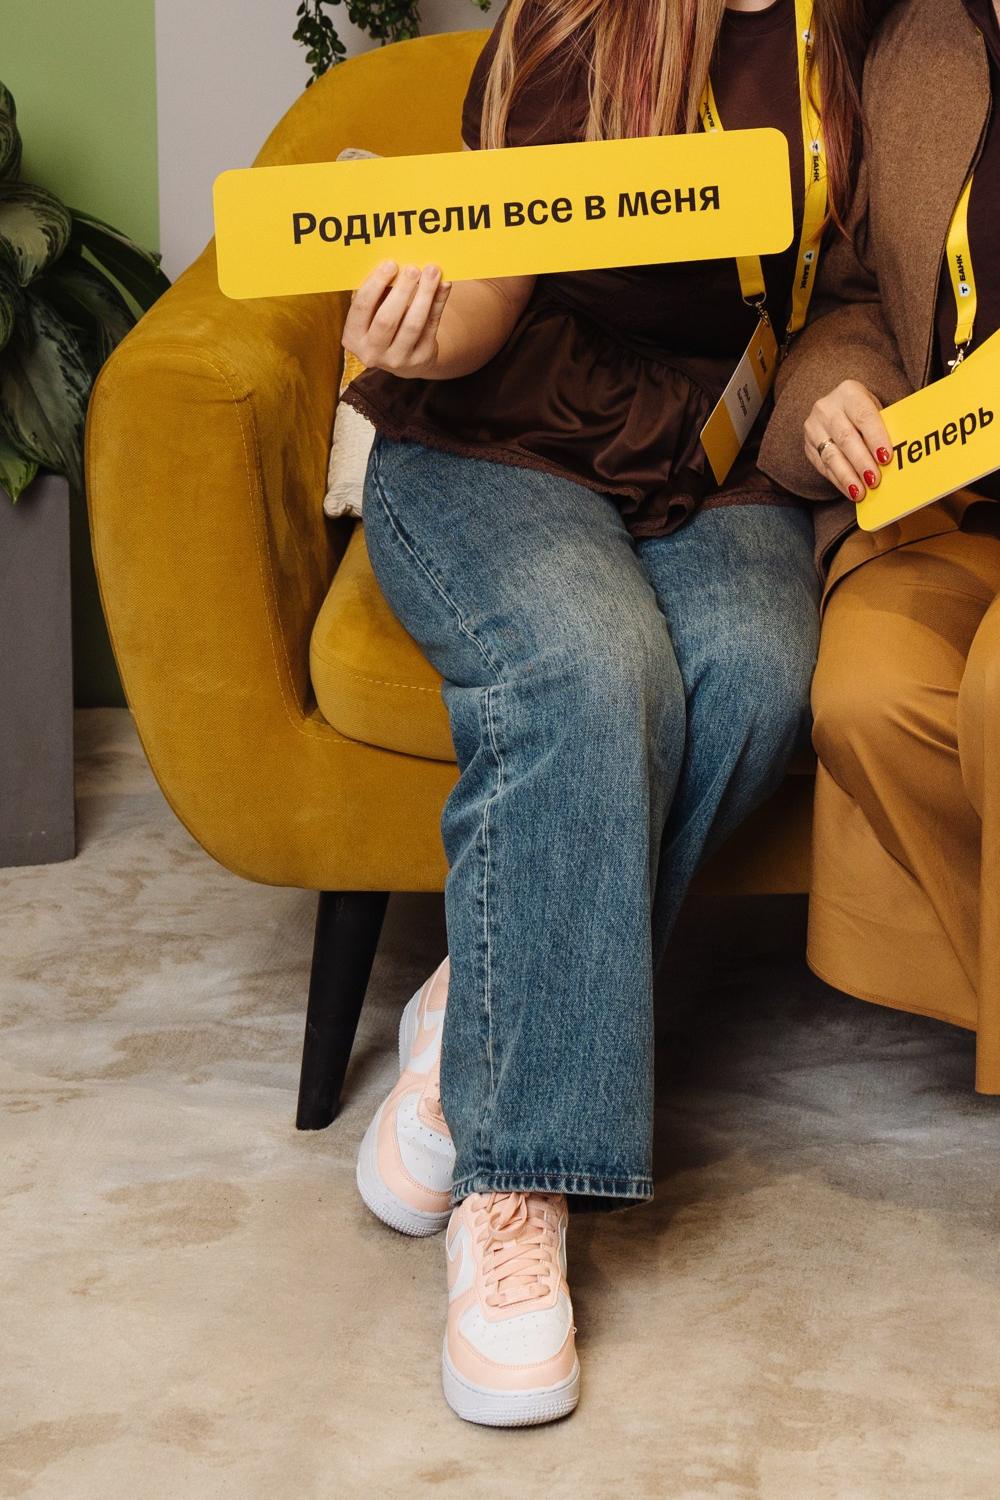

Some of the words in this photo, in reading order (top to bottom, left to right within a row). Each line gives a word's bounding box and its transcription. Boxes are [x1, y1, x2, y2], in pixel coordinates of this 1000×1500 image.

[812, 155, 820, 182] БАНК
[292, 204, 491, 247] Родители
[503, 197, 574, 227] все
[584, 195, 607, 221] в
[617, 185, 720, 218] меня
[956, 254, 967, 282] БАНК
[893, 407, 995, 471] Теперь
